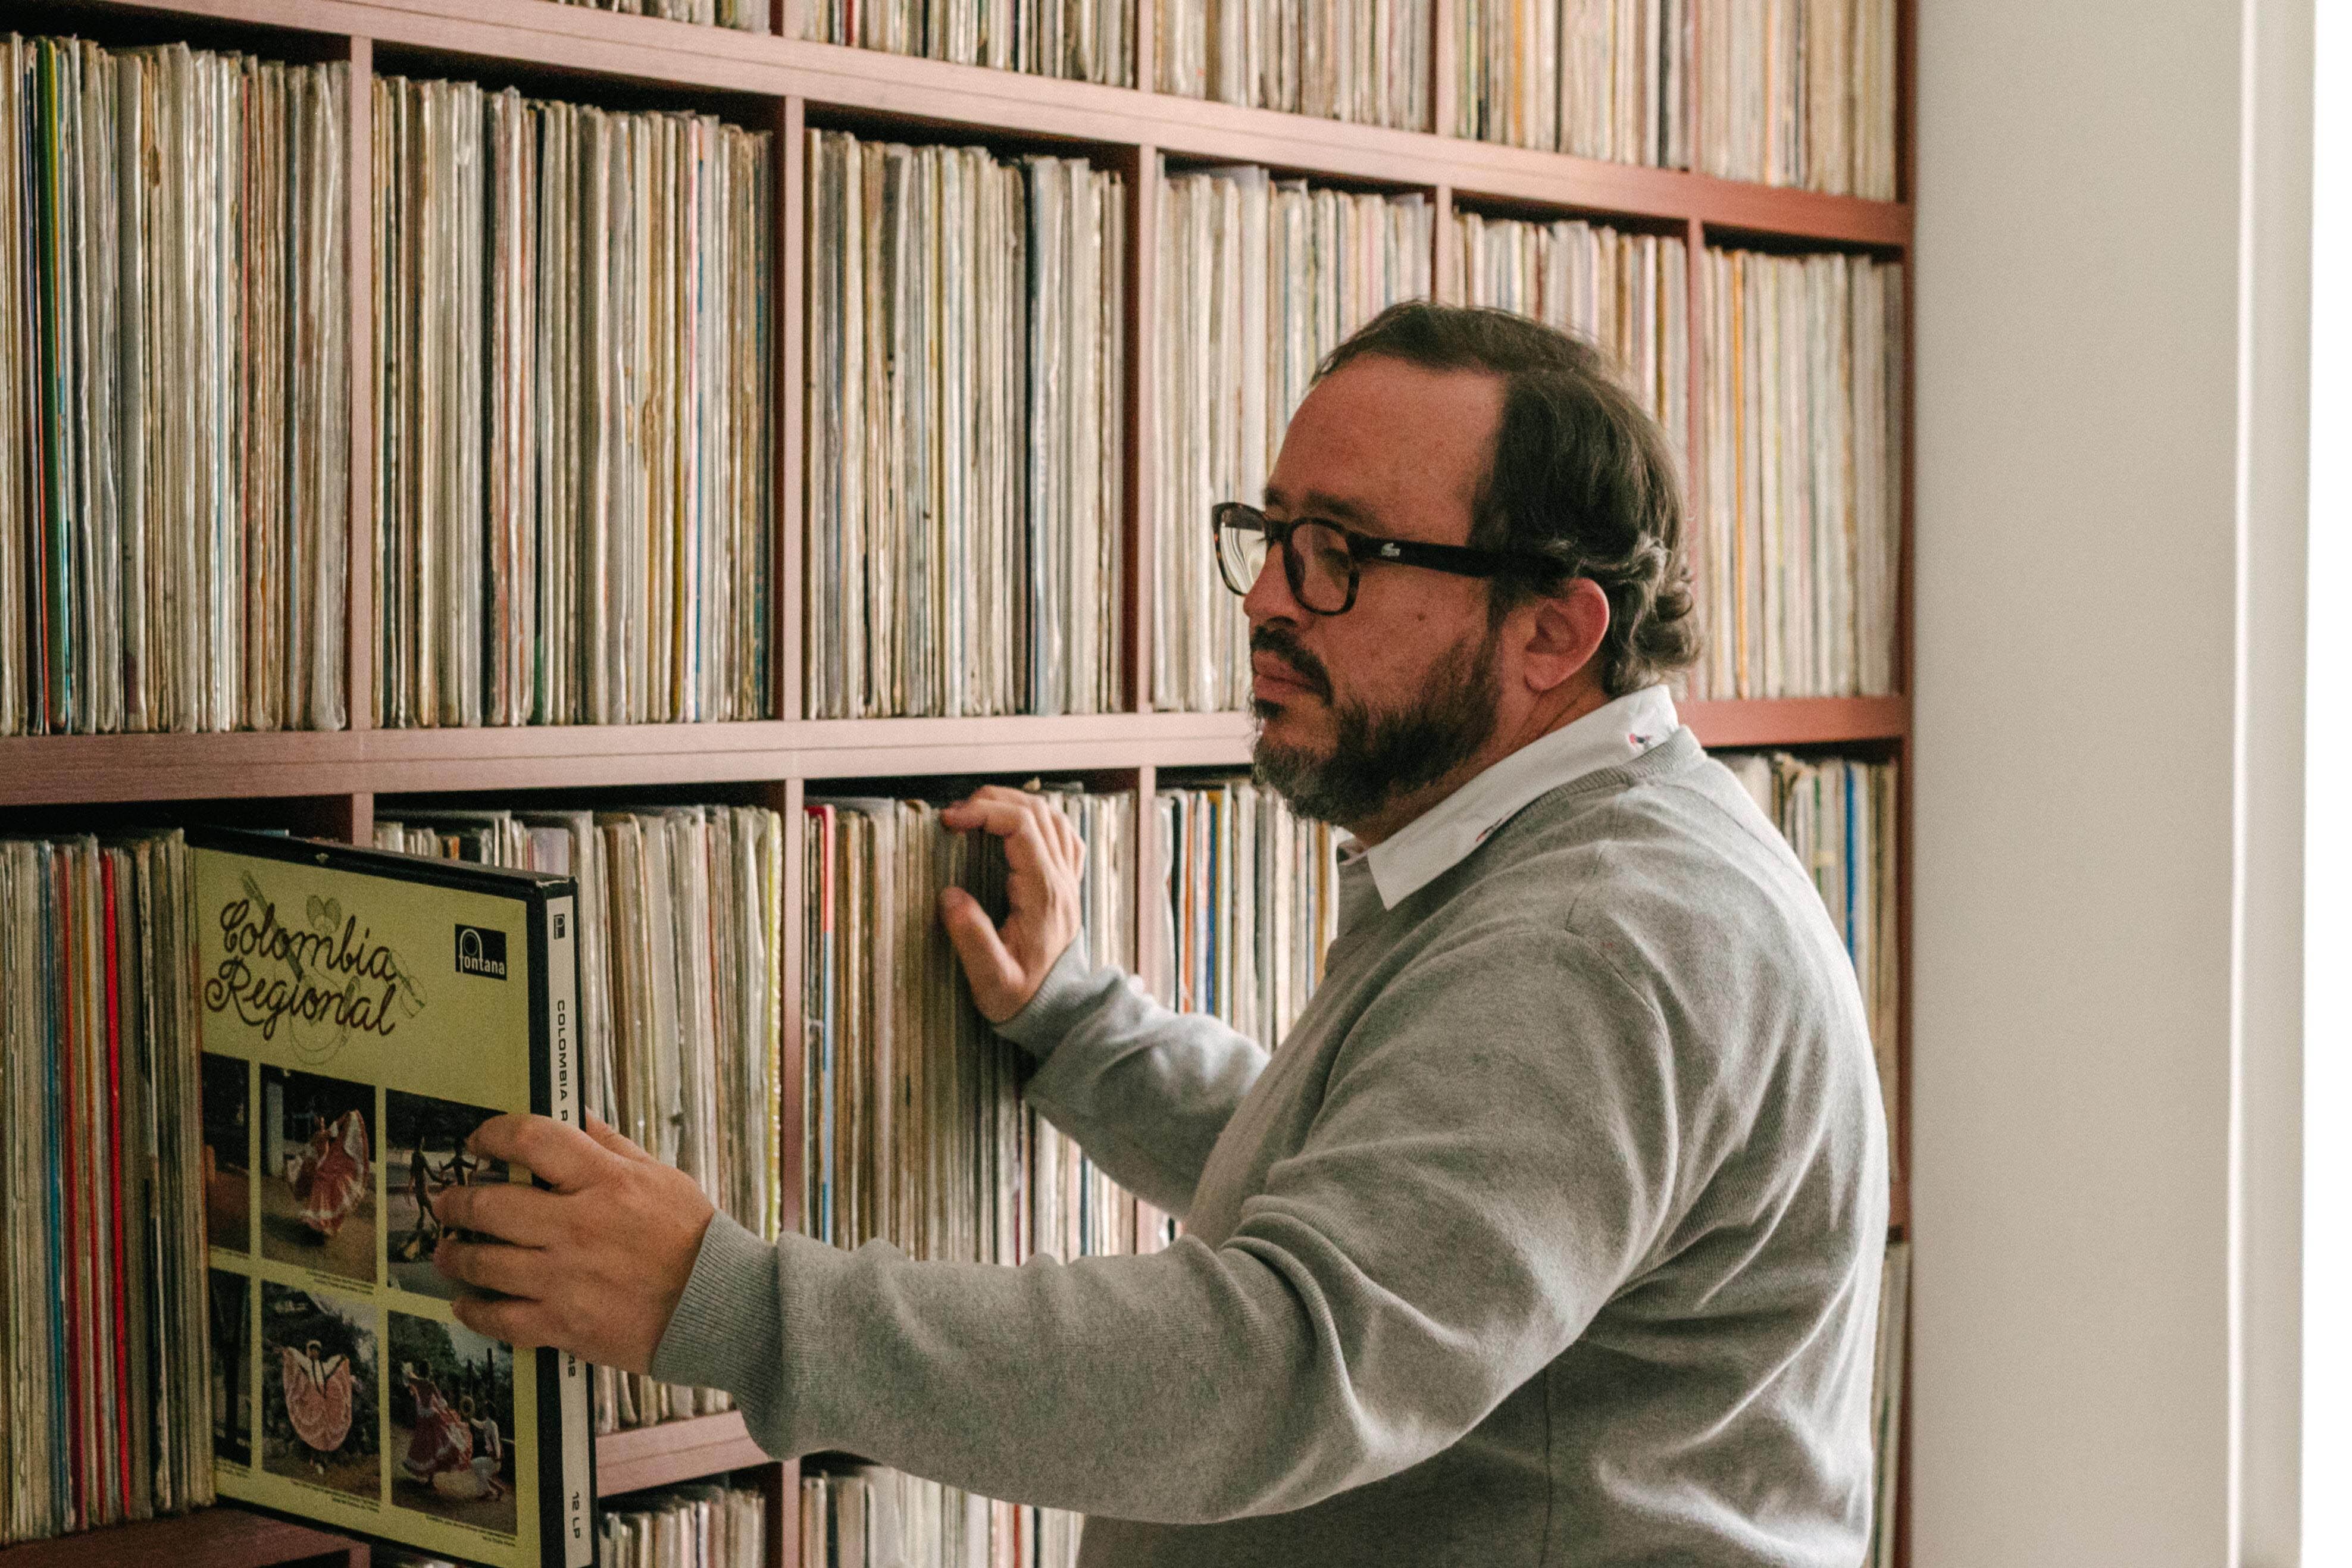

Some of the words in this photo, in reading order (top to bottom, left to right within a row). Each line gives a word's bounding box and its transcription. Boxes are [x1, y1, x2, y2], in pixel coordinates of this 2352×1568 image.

[220, 899, 397, 981] Colombia
[205, 955, 396, 1040] Regional
[558, 1000, 568, 1101] COLOMBIA
[572, 1491, 579, 1511] 12
[573, 1517, 580, 1539] LP
